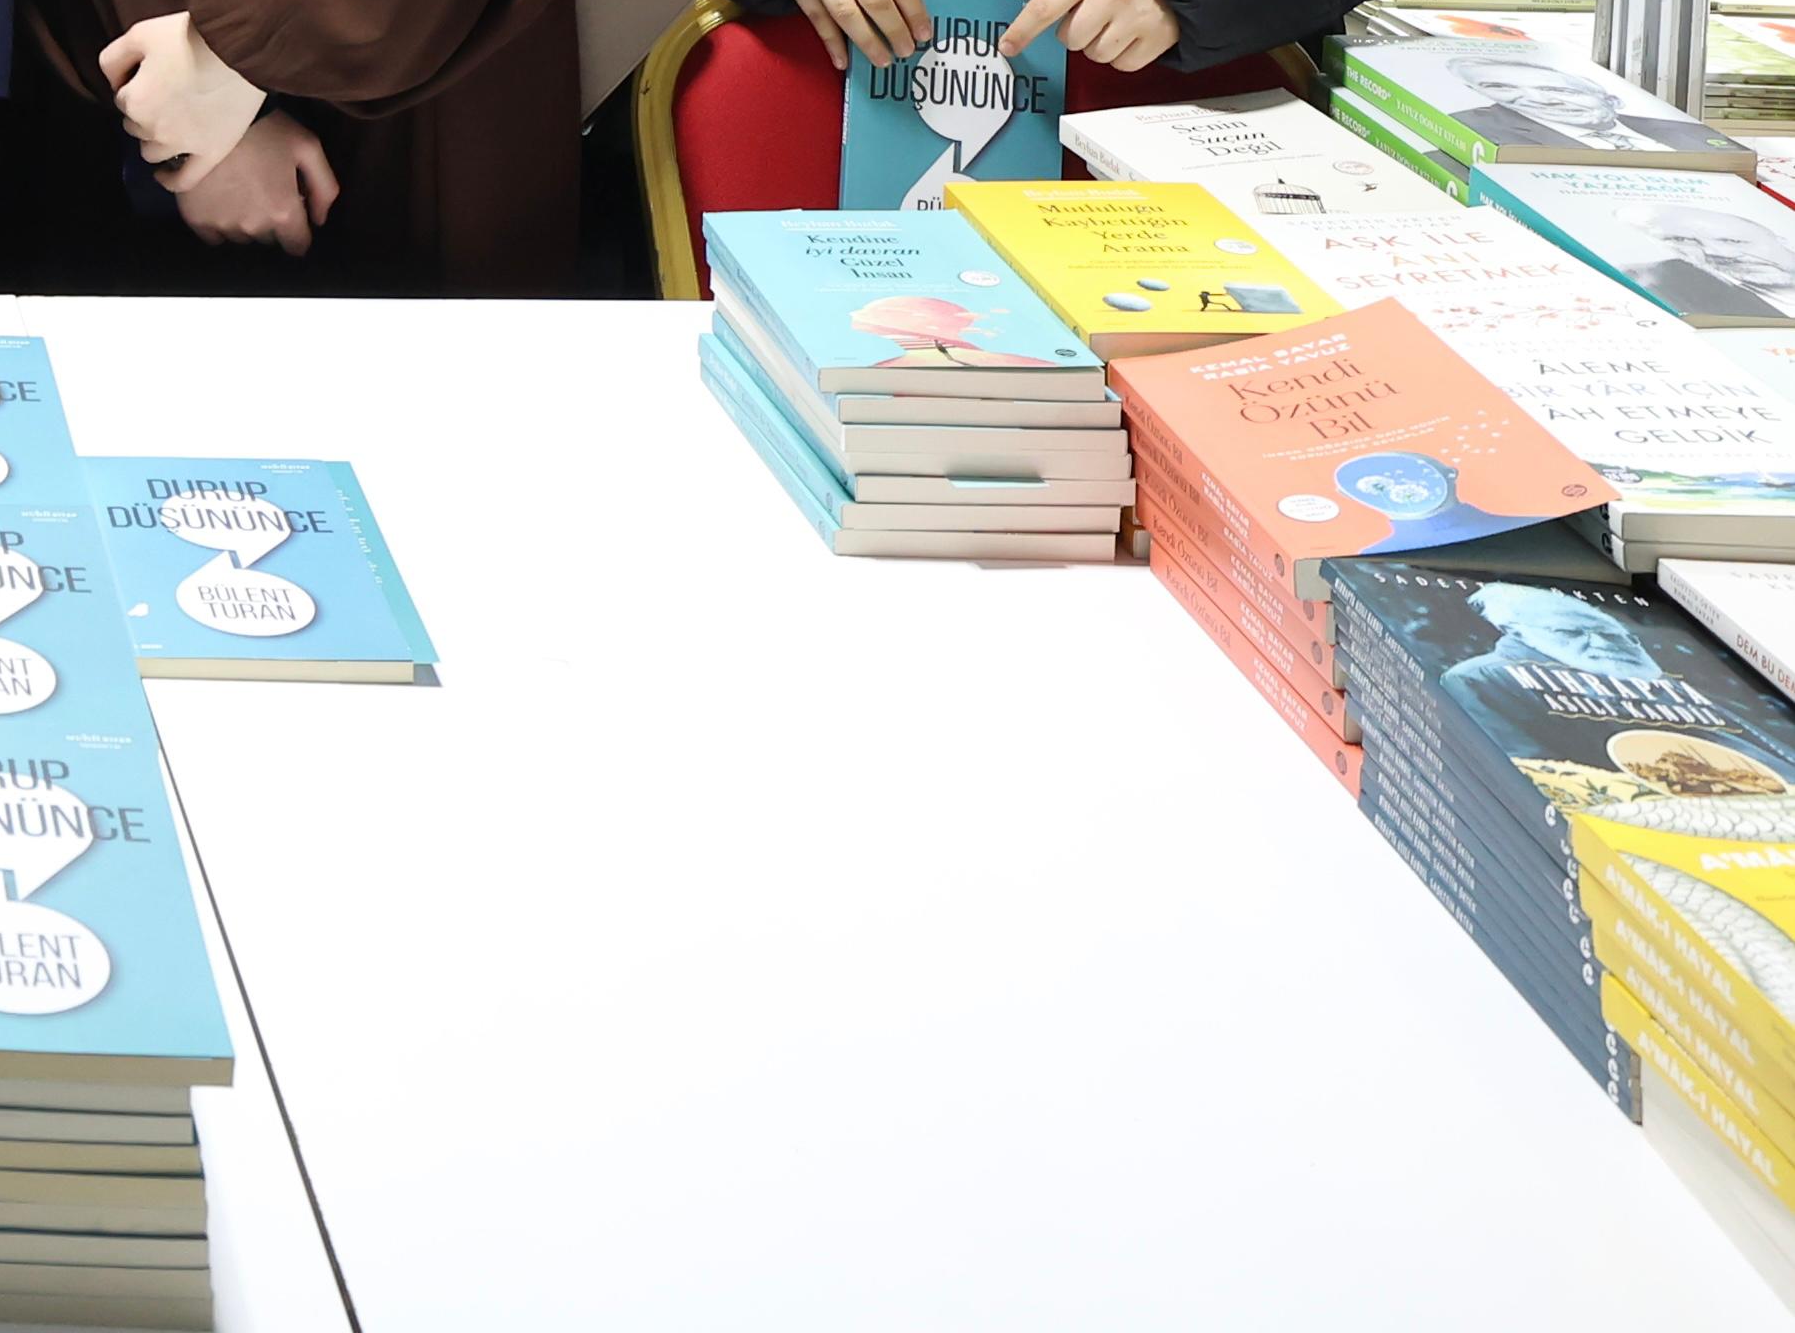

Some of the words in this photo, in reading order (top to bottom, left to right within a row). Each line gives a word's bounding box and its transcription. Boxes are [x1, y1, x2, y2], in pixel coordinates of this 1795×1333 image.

[869, 59, 1050, 115] DÜŞÜNÜNCE
[1171, 119, 1249, 135] Senin
[806, 234, 900, 245] Kendine
[1090, 230, 1169, 241] Yerde
[1102, 242, 1191, 254] Arama
[1335, 262, 1575, 291] SEYRETMEK
[1227, 357, 1367, 402] Kendi
[1239, 379, 1403, 425] Özünü
[1308, 410, 1377, 441] Bil
[146, 477, 268, 501] DURUP
[106, 501, 334, 535] DÜŞÜNÜNCE
[198, 583, 295, 605] BÜLENT
[201, 602, 297, 622] TURAN
[1503, 662, 1717, 708] MİHRAPTA
